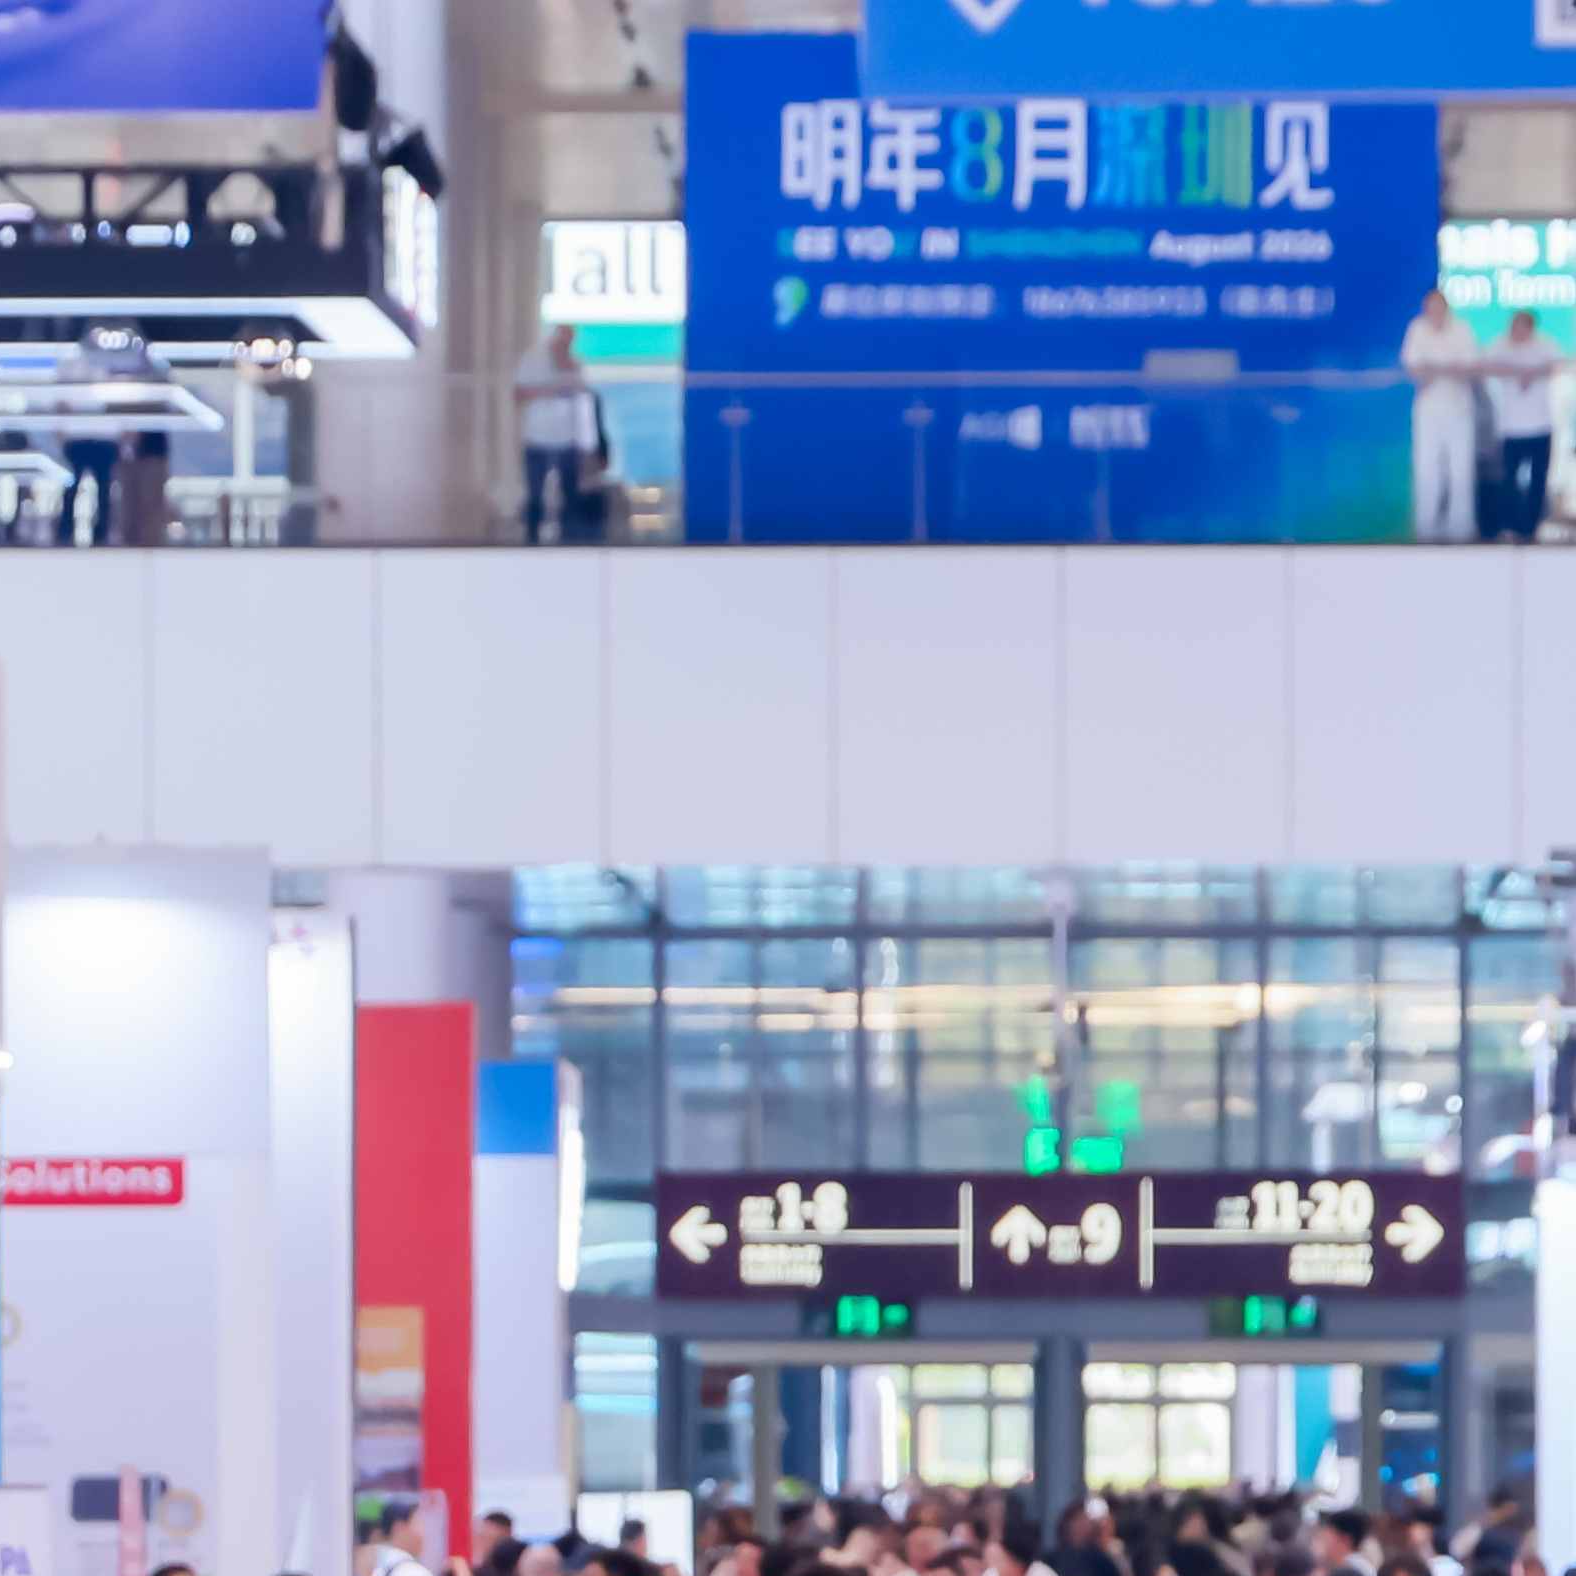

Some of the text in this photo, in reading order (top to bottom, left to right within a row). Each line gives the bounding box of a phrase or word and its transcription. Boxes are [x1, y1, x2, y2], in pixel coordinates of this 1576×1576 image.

[780, 98, 1336, 213] 明年8月深圳见
